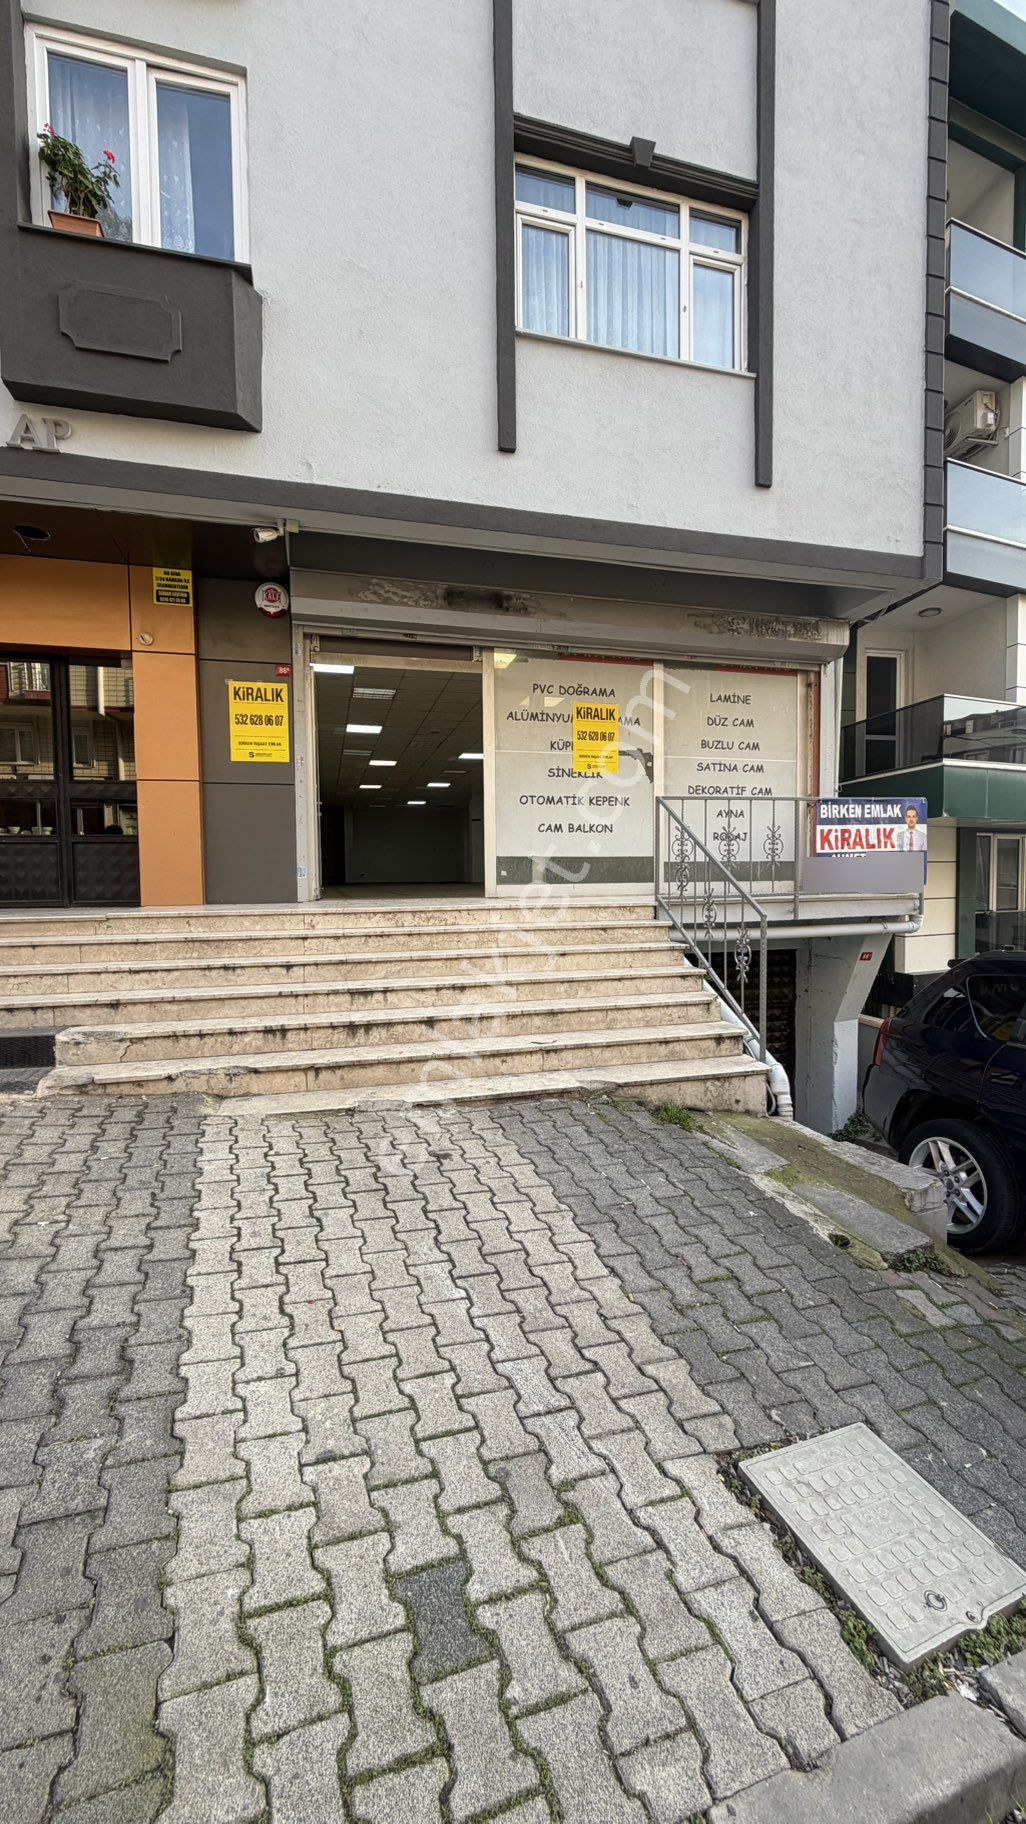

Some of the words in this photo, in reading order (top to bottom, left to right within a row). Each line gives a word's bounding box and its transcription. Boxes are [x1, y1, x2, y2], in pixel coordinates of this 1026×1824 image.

[5, 413, 72, 453] AP
[532, 683, 554, 695] PVC
[559, 683, 615, 698] DOĞRAMA
[709, 692, 751, 705] LAMİNE
[234, 713, 248, 725] 532
[250, 714, 263, 726] 628
[264, 715, 273, 726] 06
[275, 715, 284, 726] 07
[507, 709, 573, 723] ALÜMİNYU
[707, 715, 728, 727] DÜZ
[732, 719, 754, 728] CAM
[577, 731, 587, 741] 532
[588, 731, 599, 741] 628
[701, 740, 734, 750] BUZLU
[738, 741, 760, 751] CAM
[696, 761, 738, 772] SATİNA
[742, 764, 764, 773] CAM
[688, 785, 746, 795] DEKORATİF
[751, 787, 772, 796] CAM
[519, 794, 585, 806] OTOMATİK
[588, 796, 630, 807] KEPENK
[716, 809, 745, 818] AYNA
[820, 801, 862, 818] BİRKEN
[864, 804, 902, 818] EMLAK
[538, 823, 563, 834] CAM
[568, 823, 613, 834] BALKON
